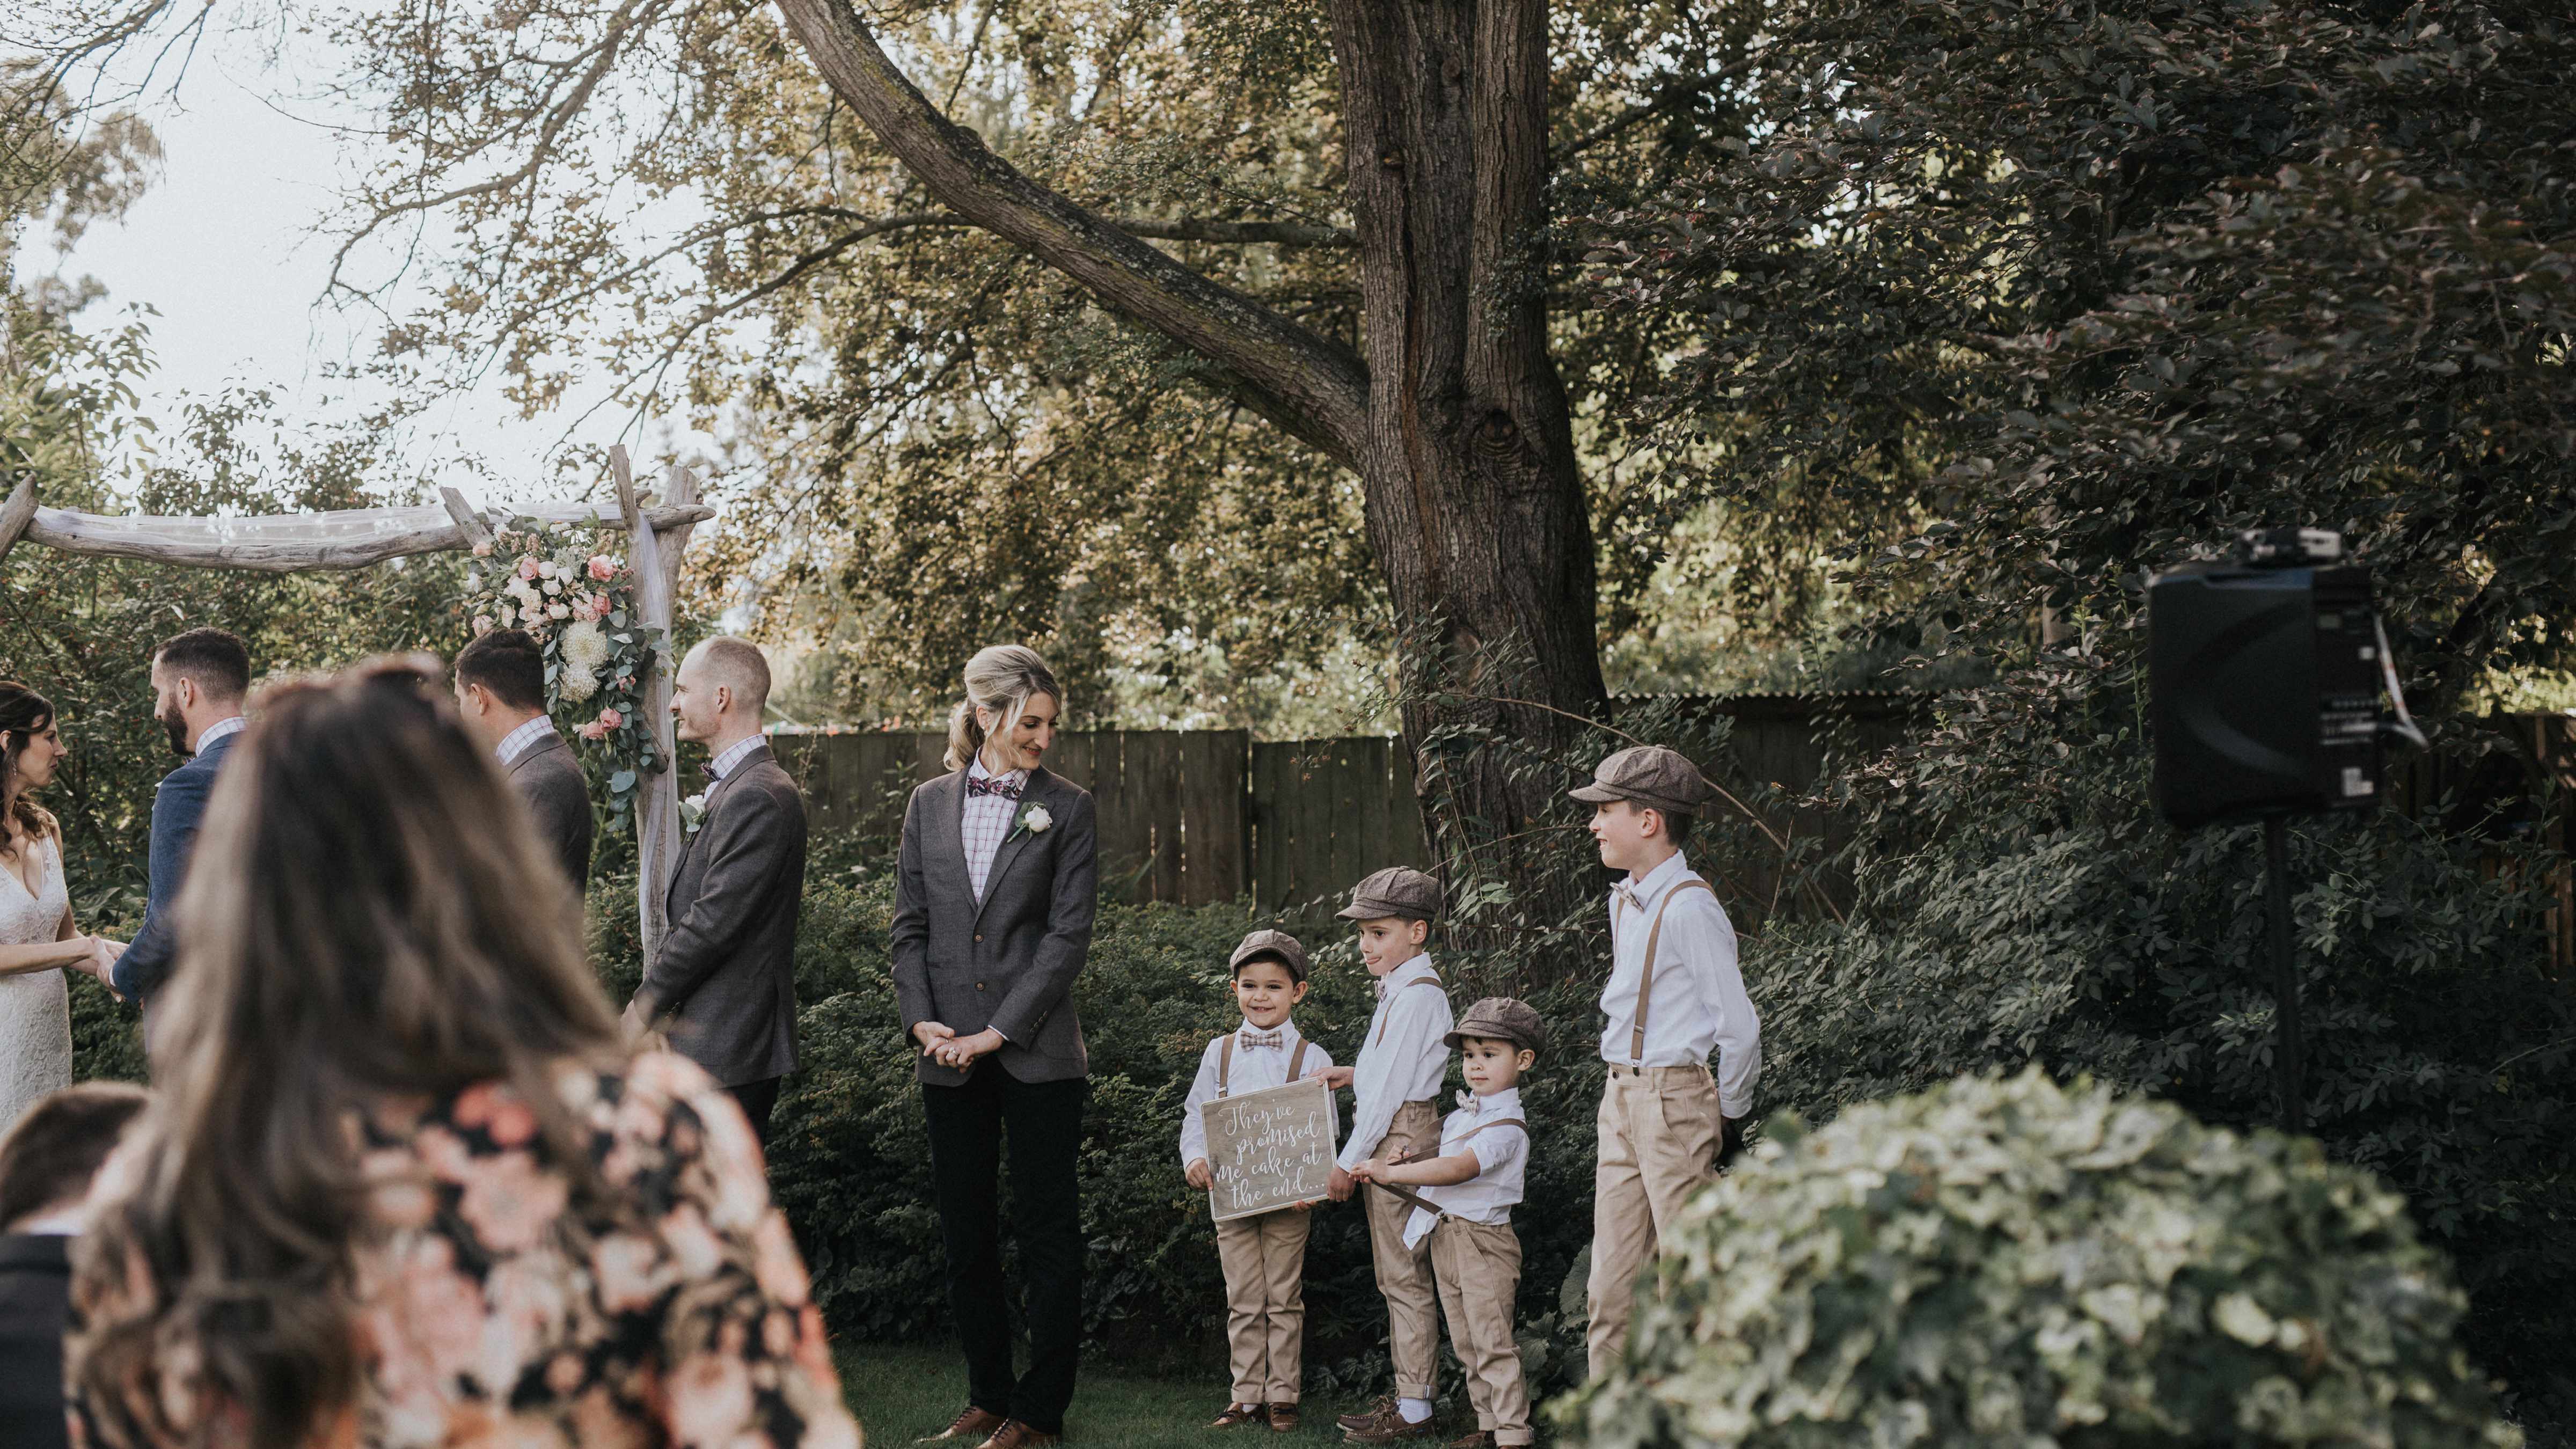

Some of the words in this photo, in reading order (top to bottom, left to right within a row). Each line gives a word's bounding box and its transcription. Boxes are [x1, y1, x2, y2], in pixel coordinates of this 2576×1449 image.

[1218, 1099, 1295, 1136] They've
[1236, 1111, 1320, 1165] promised
[1251, 1146, 1294, 1177] cake
[1302, 1141, 1322, 1165] at
[1232, 1179, 1263, 1209] the
[1272, 1166, 1324, 1197] end...
